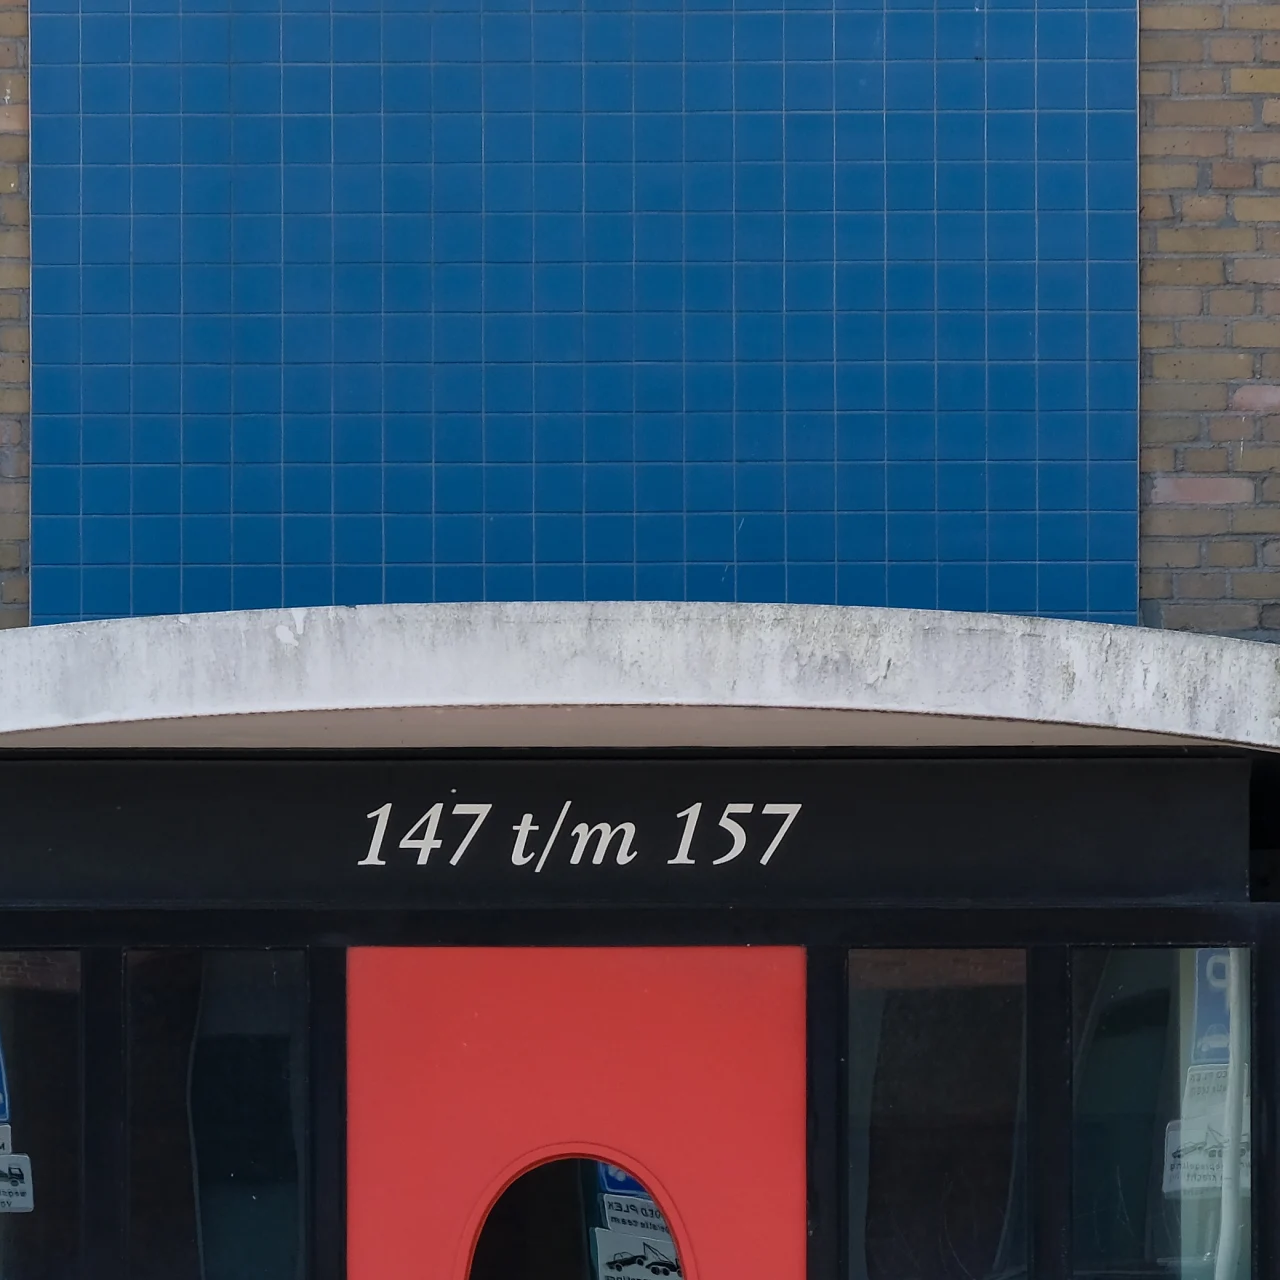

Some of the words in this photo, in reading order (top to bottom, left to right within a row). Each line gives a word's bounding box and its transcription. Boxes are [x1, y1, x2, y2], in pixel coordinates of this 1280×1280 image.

[356, 802, 493, 867] 147
[510, 800, 638, 873] t/m
[666, 802, 803, 867] 157
